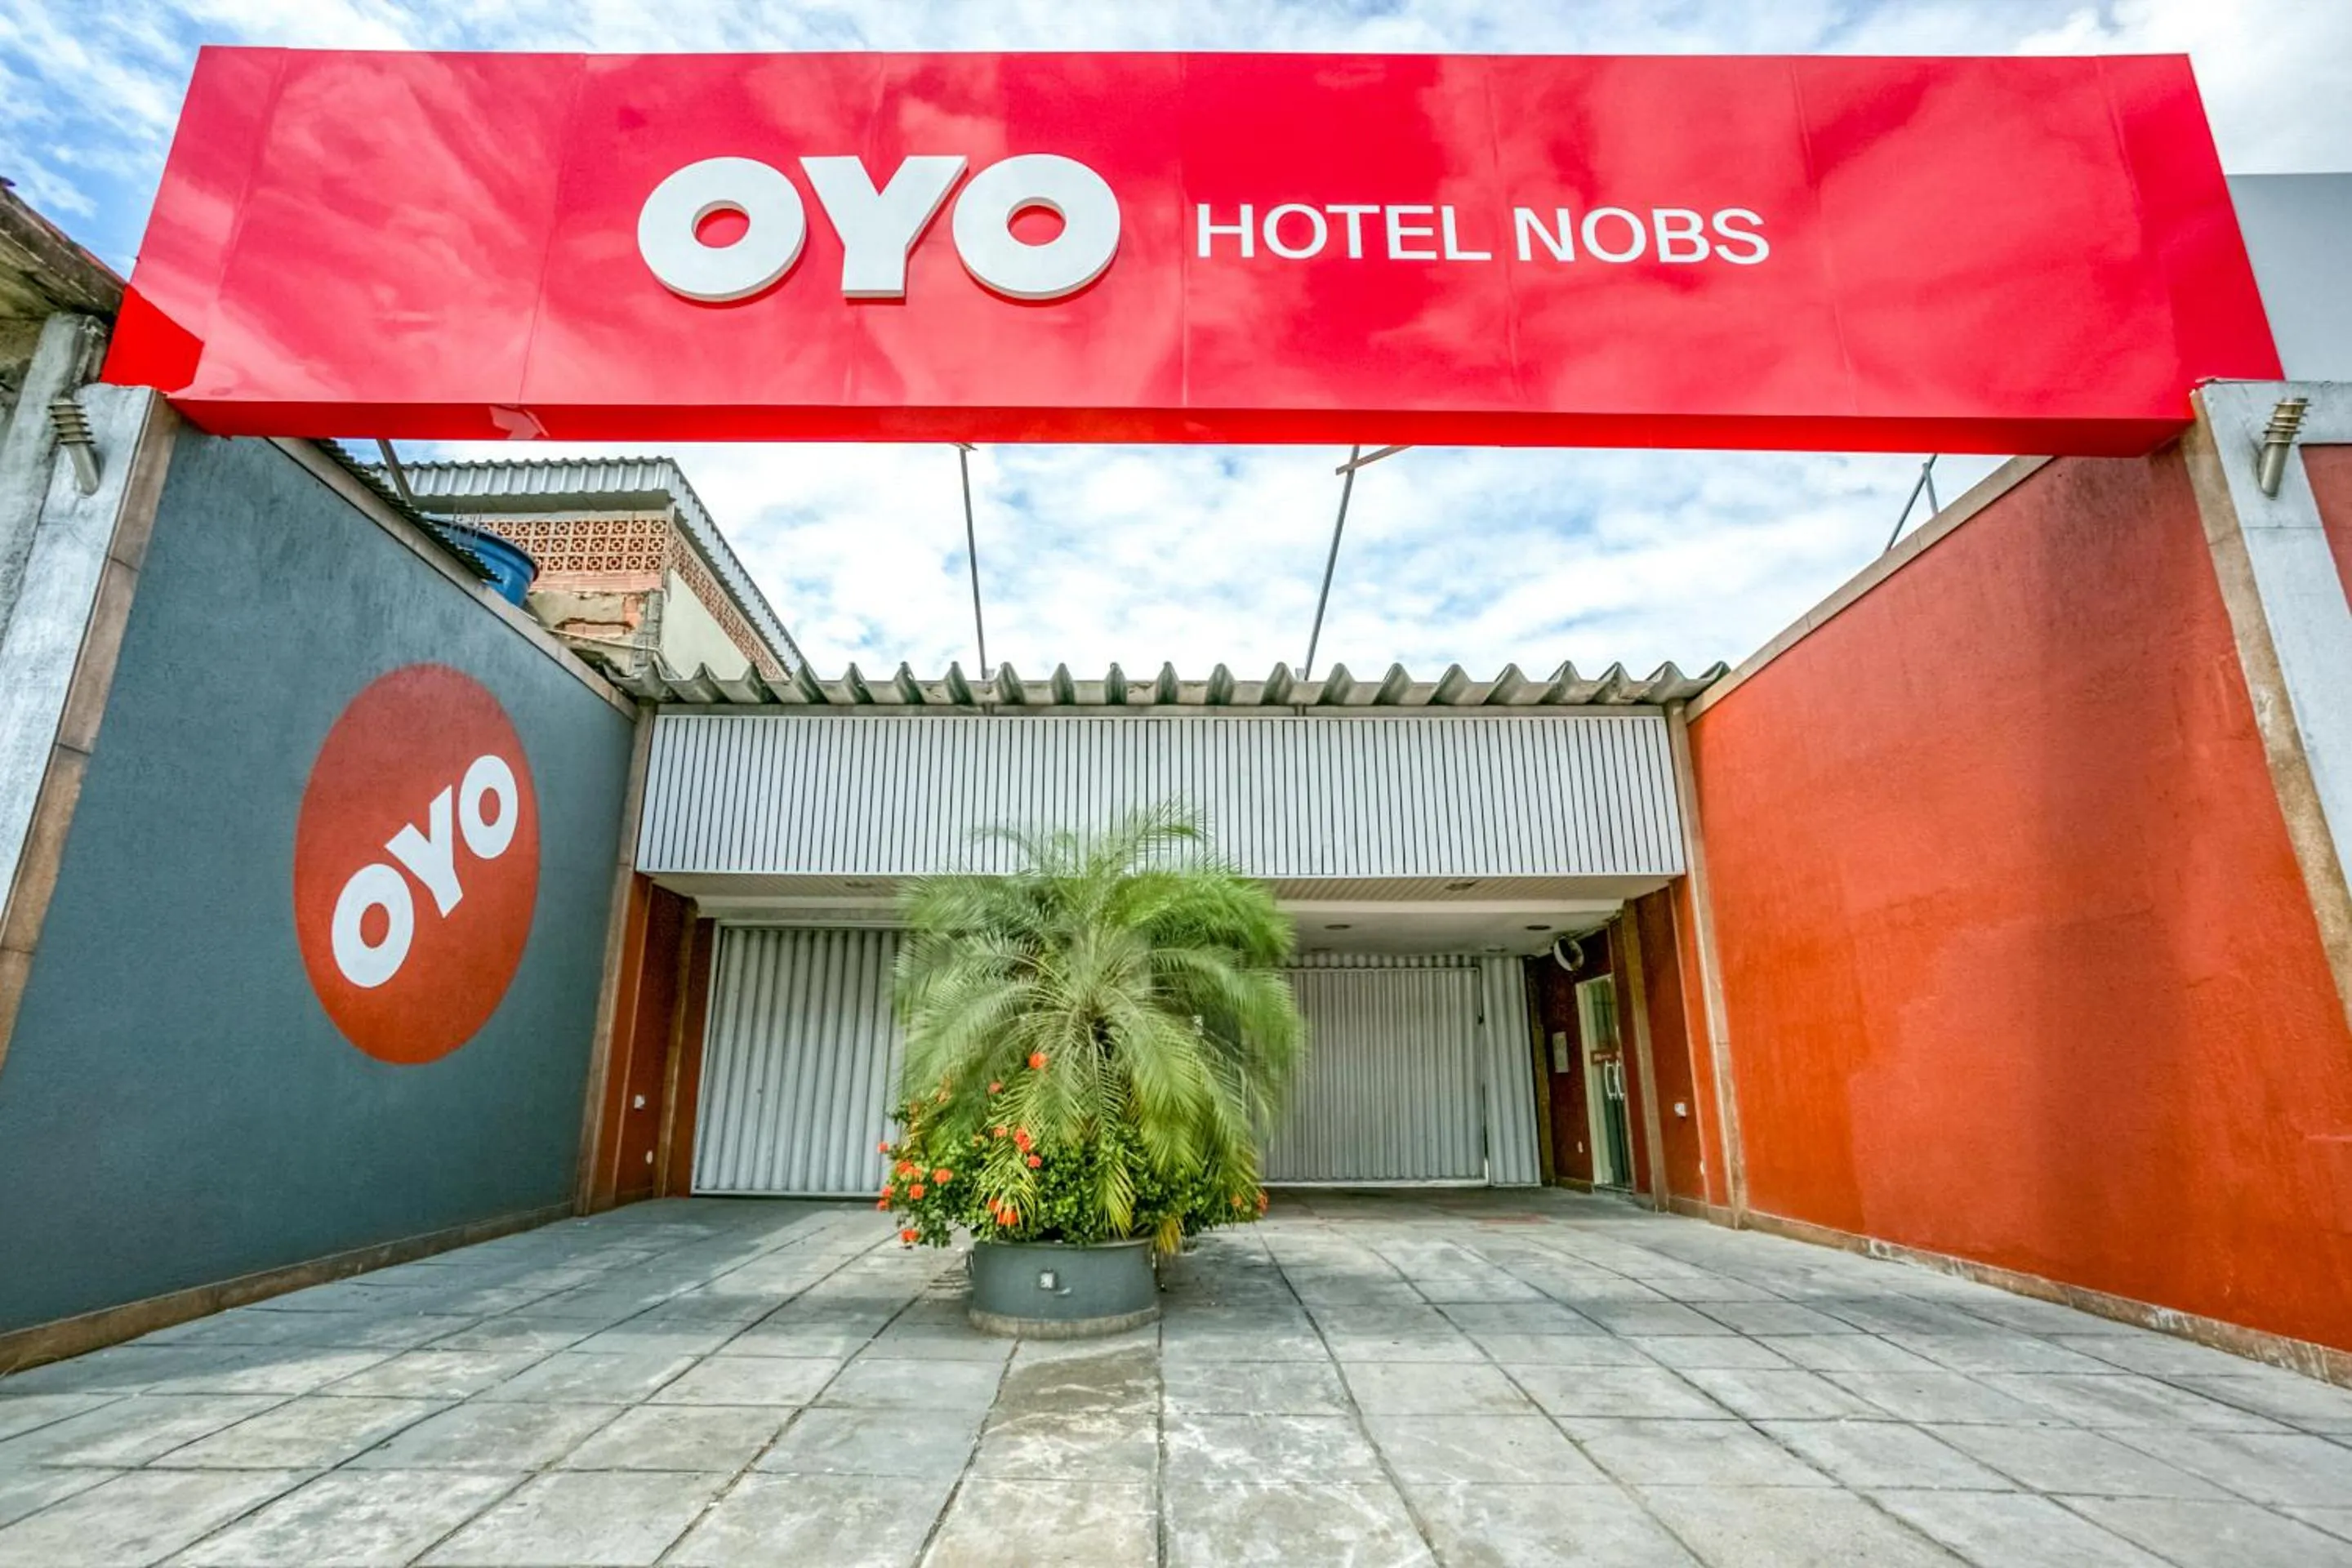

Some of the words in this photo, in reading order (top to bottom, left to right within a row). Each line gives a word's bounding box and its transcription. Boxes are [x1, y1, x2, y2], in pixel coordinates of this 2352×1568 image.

[637, 154, 1121, 301] OYO
[1198, 203, 1492, 261] HOTEL
[1514, 207, 1771, 265] NOBS
[332, 753, 519, 989] OYO
